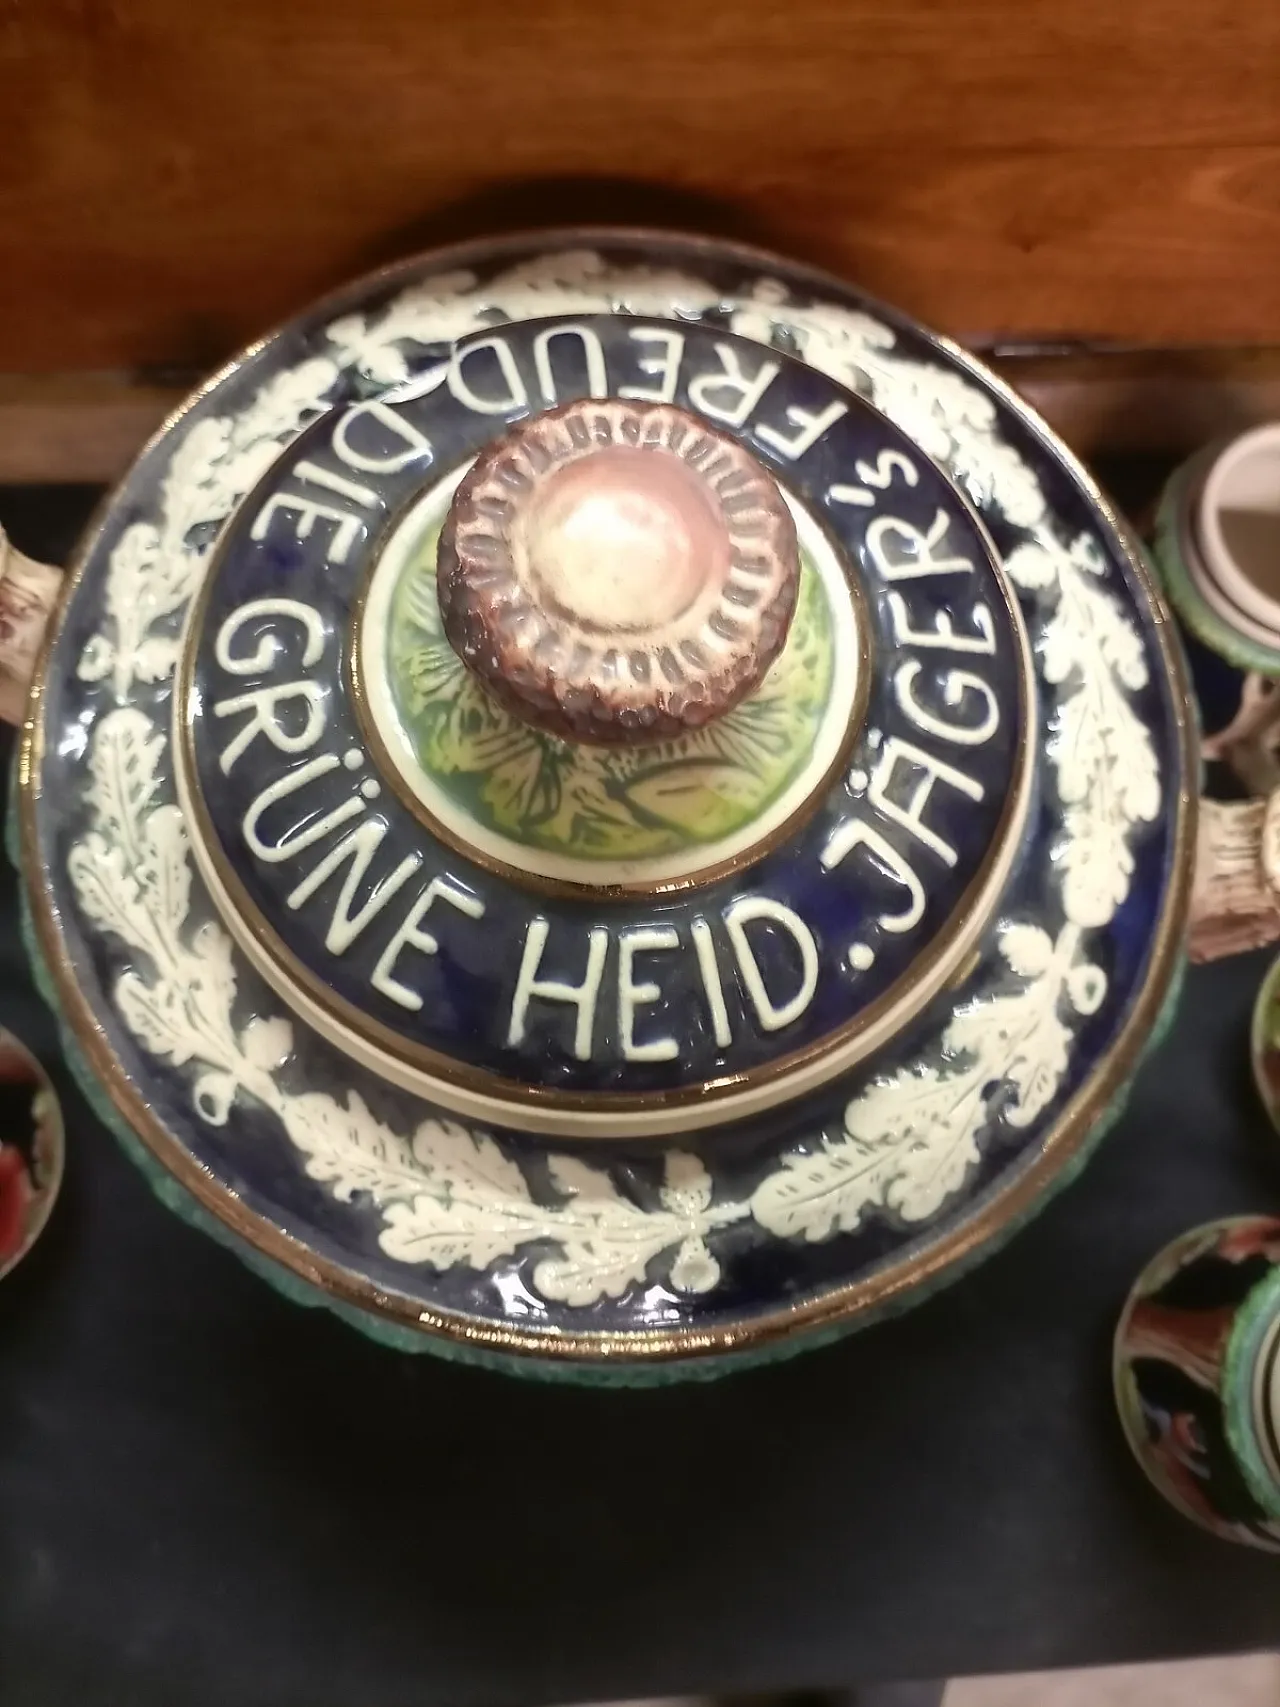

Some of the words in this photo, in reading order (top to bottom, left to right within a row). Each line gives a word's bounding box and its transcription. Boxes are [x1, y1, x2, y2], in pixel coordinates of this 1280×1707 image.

[446, 324, 849, 461] FREUD
[250, 401, 433, 565] DIE
[213, 598, 485, 1011] GRÜNE
